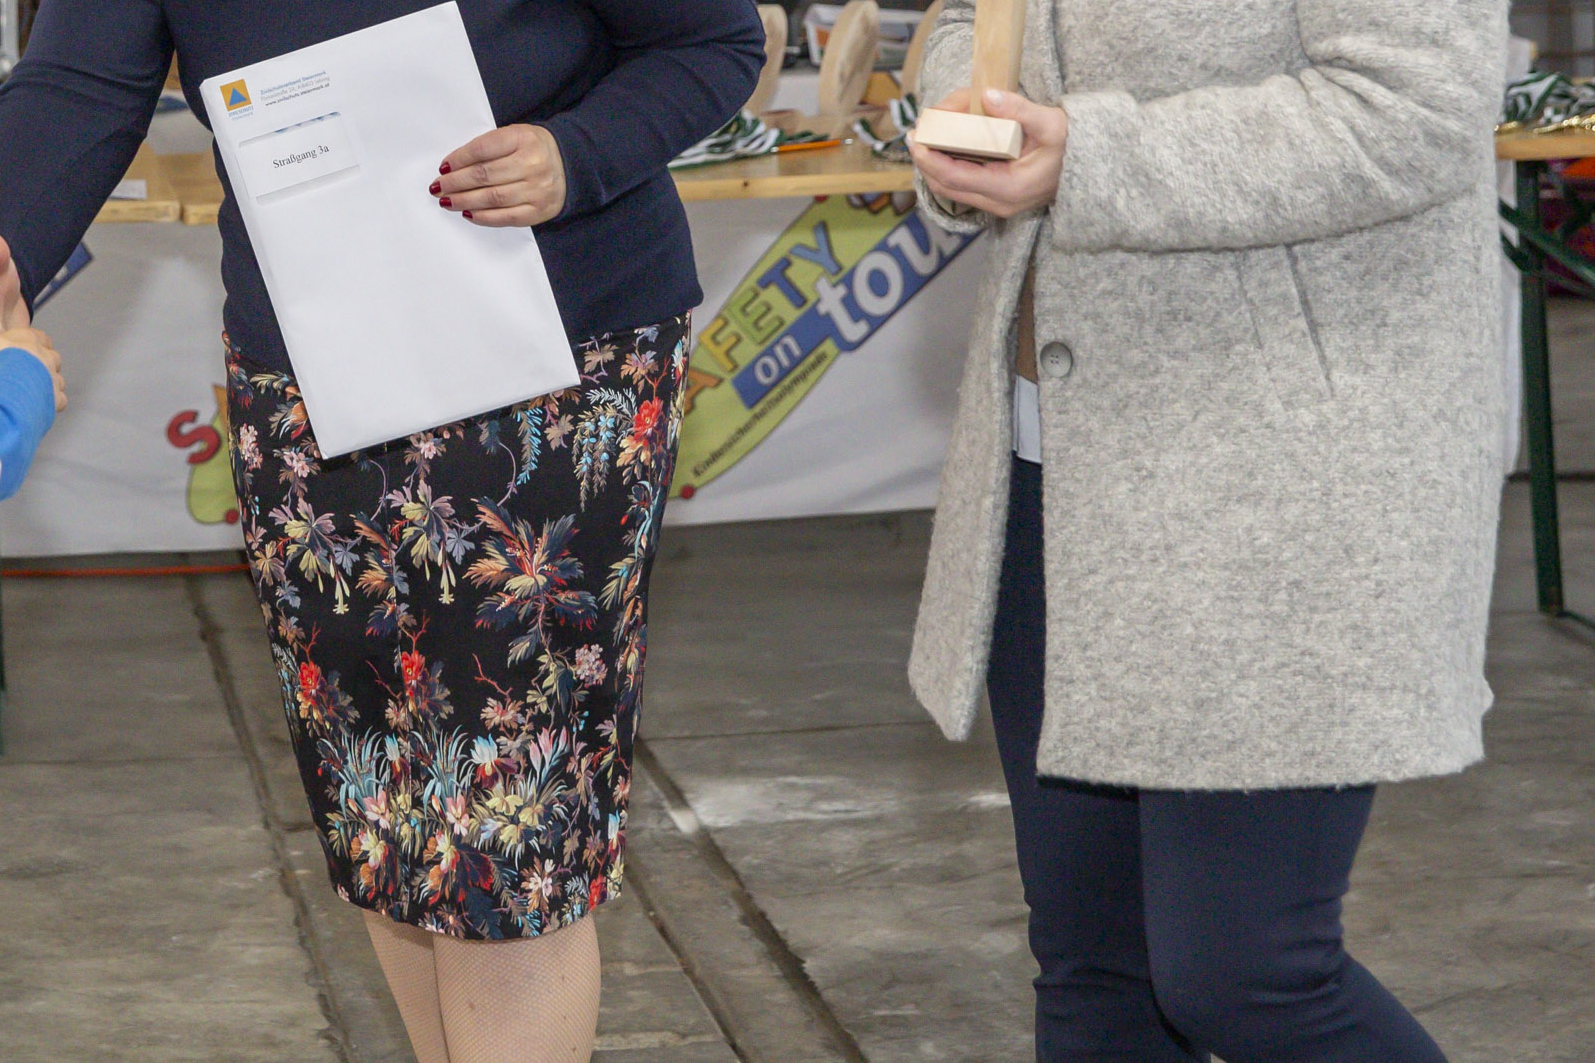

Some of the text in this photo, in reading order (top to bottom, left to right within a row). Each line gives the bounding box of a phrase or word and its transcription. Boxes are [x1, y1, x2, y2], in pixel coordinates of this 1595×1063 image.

[273, 145, 330, 169] Straßgang 3a
[682, 220, 843, 416] AFETY
[753, 209, 963, 386] on tou
